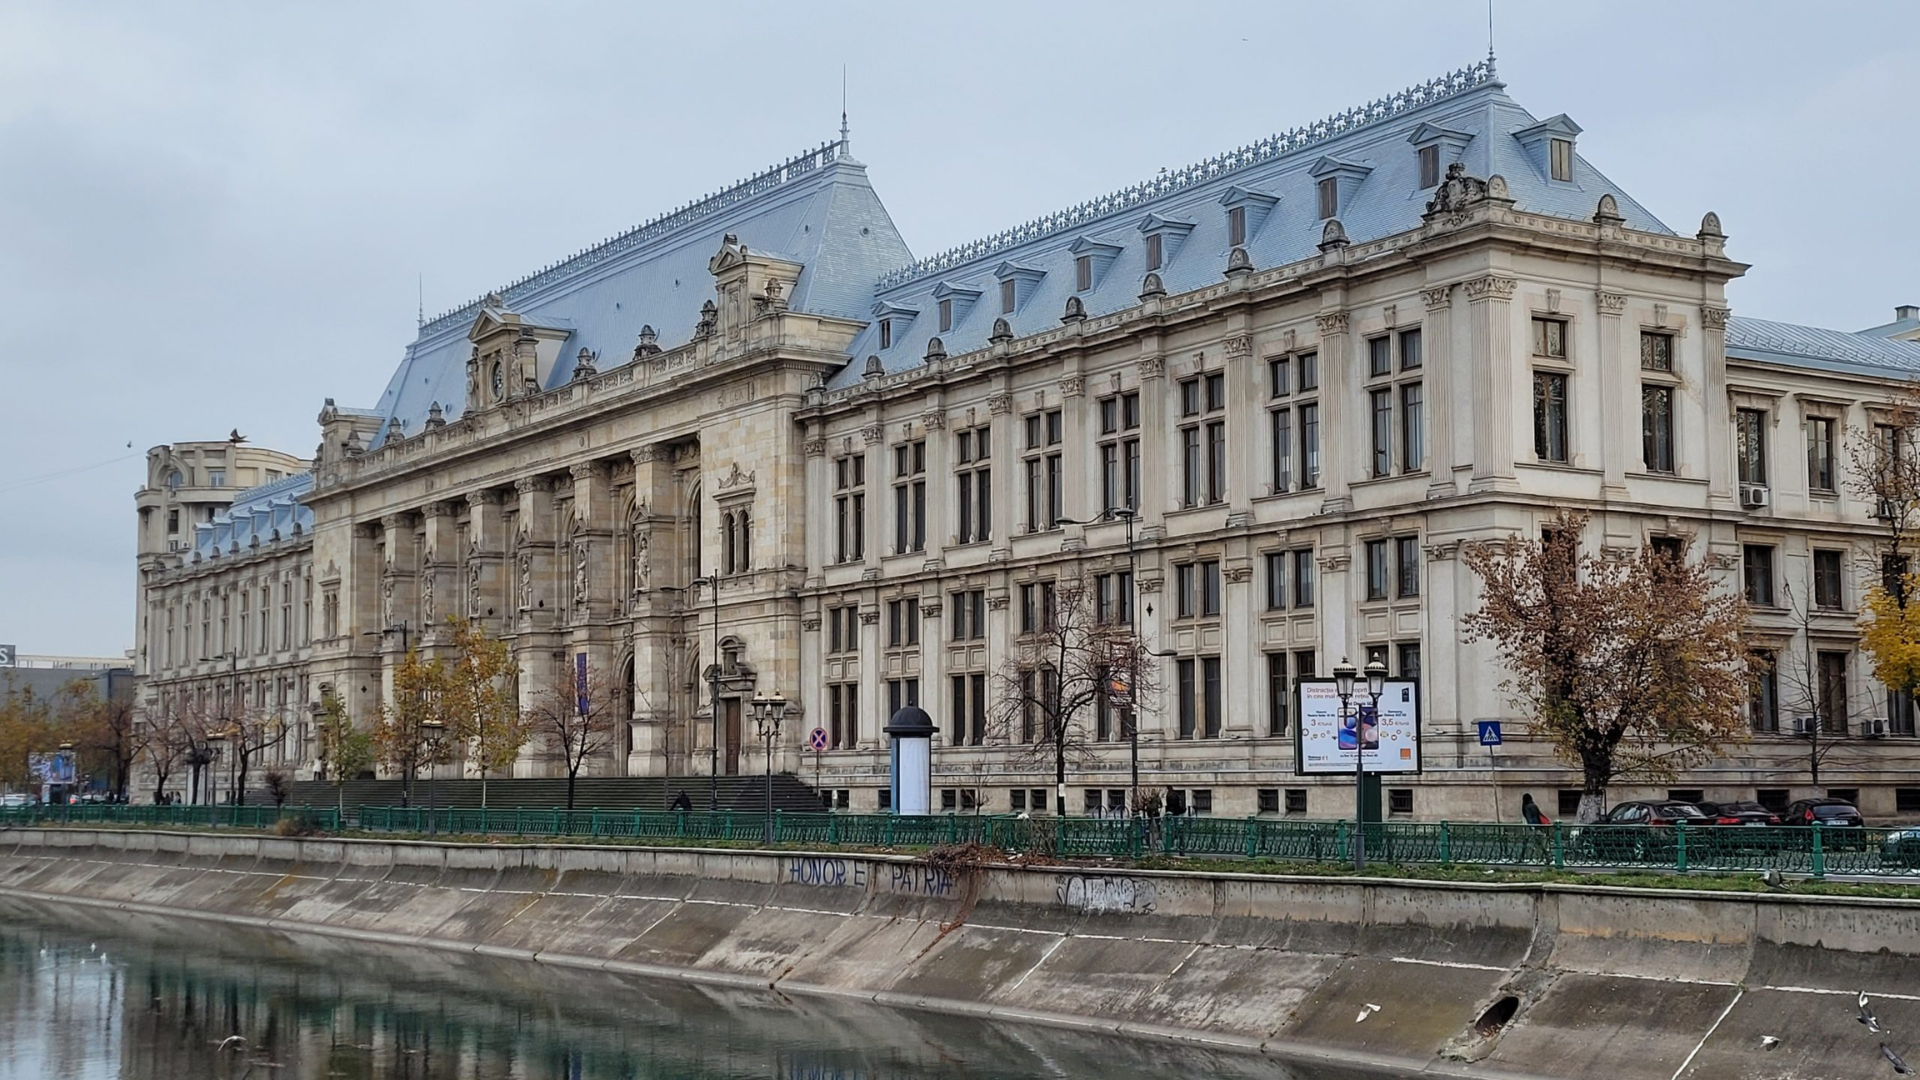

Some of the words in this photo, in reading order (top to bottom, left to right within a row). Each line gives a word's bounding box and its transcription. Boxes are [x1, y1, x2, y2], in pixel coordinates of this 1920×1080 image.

[1381, 718, 1394, 726] 3,5
[789, 857, 847, 886] HONOR
[891, 863, 953, 897] PATRIA
